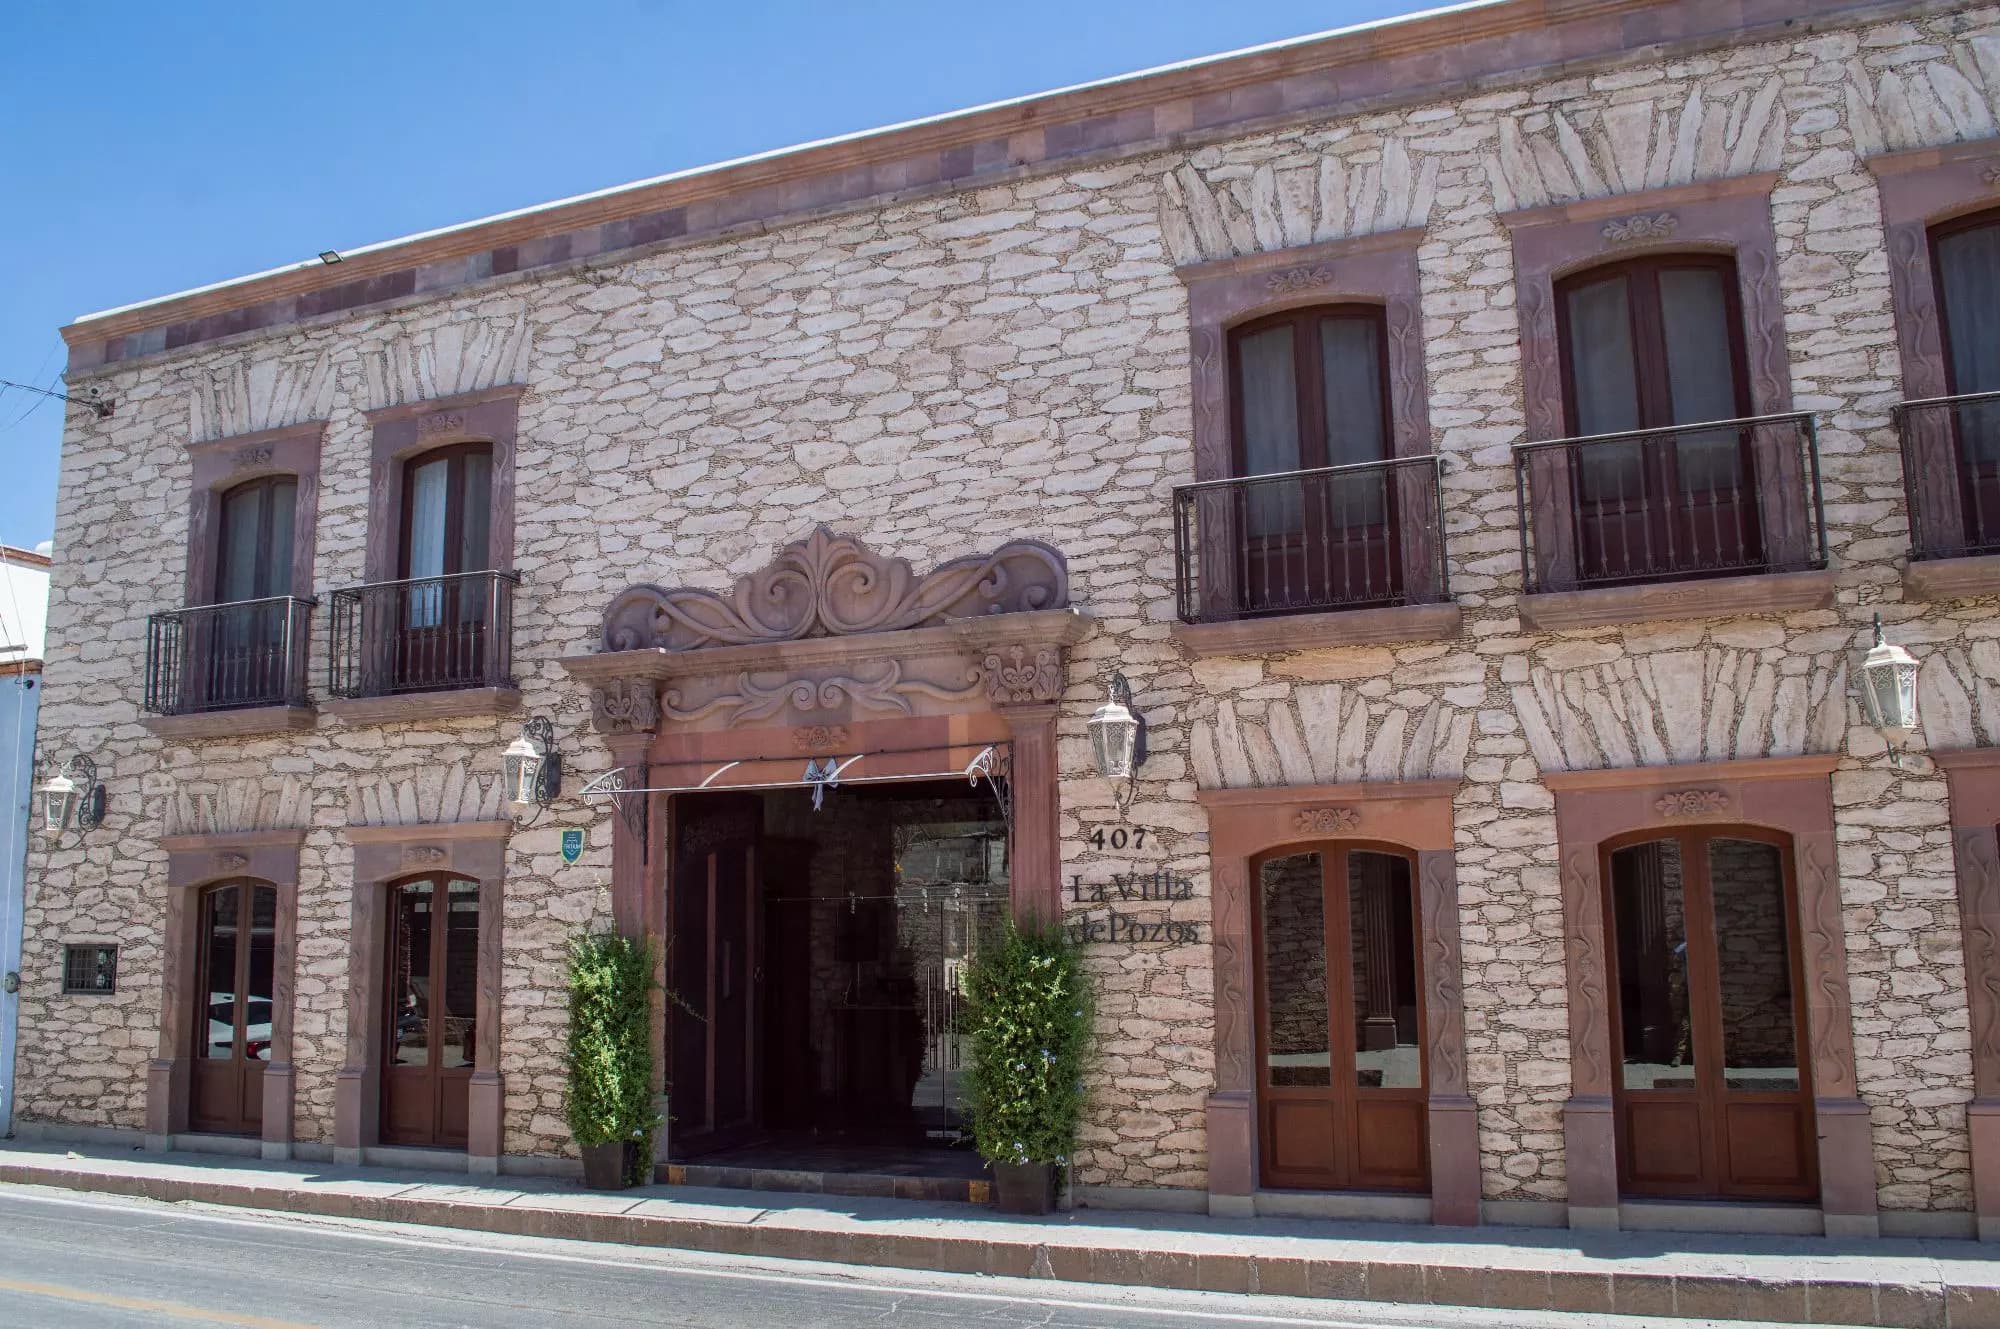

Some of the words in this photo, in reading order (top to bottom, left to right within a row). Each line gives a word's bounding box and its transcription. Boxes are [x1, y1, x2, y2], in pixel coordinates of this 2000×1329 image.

[1089, 828, 1146, 850] 407
[1070, 874, 1107, 903] La
[1109, 872, 1194, 901] Villa
[1108, 912, 1199, 943] Pozos
